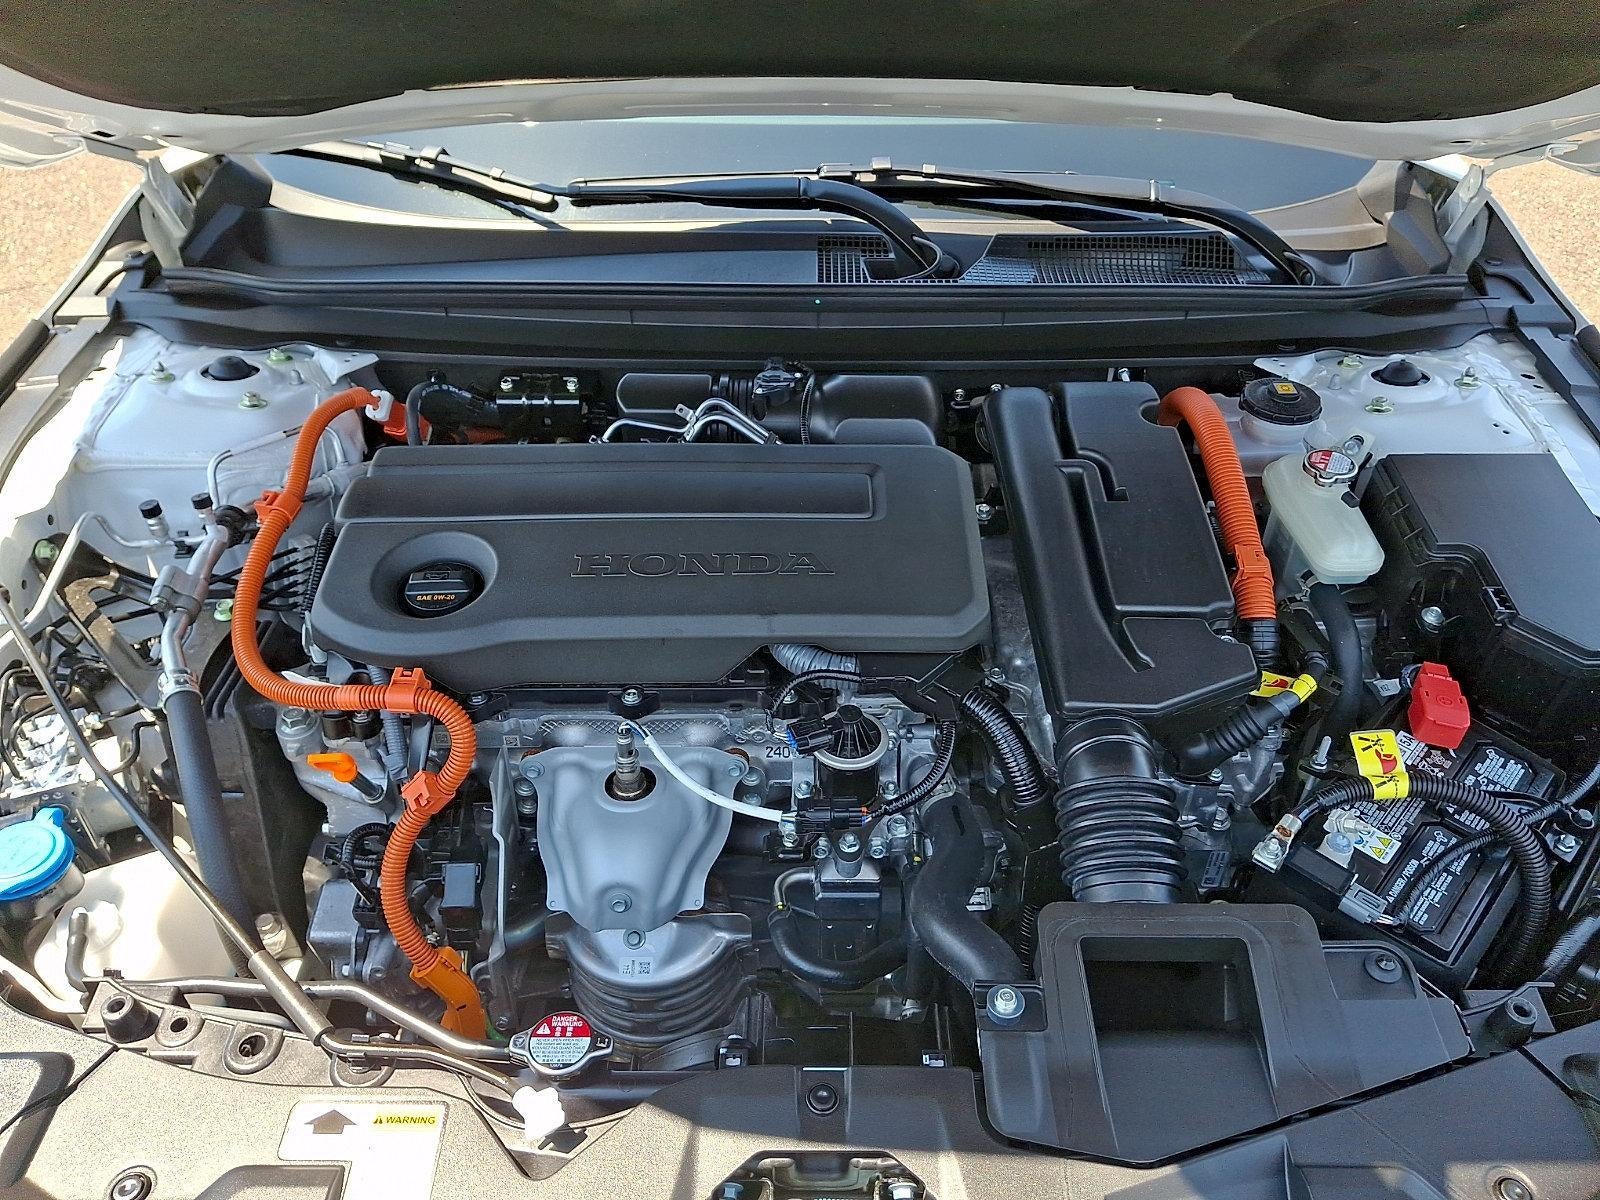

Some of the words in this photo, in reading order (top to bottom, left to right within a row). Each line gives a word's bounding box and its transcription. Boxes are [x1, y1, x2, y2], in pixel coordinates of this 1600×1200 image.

[570, 552, 836, 577] HONDA
[765, 745, 791, 759] 240
[386, 1116, 436, 1125] WARNING
